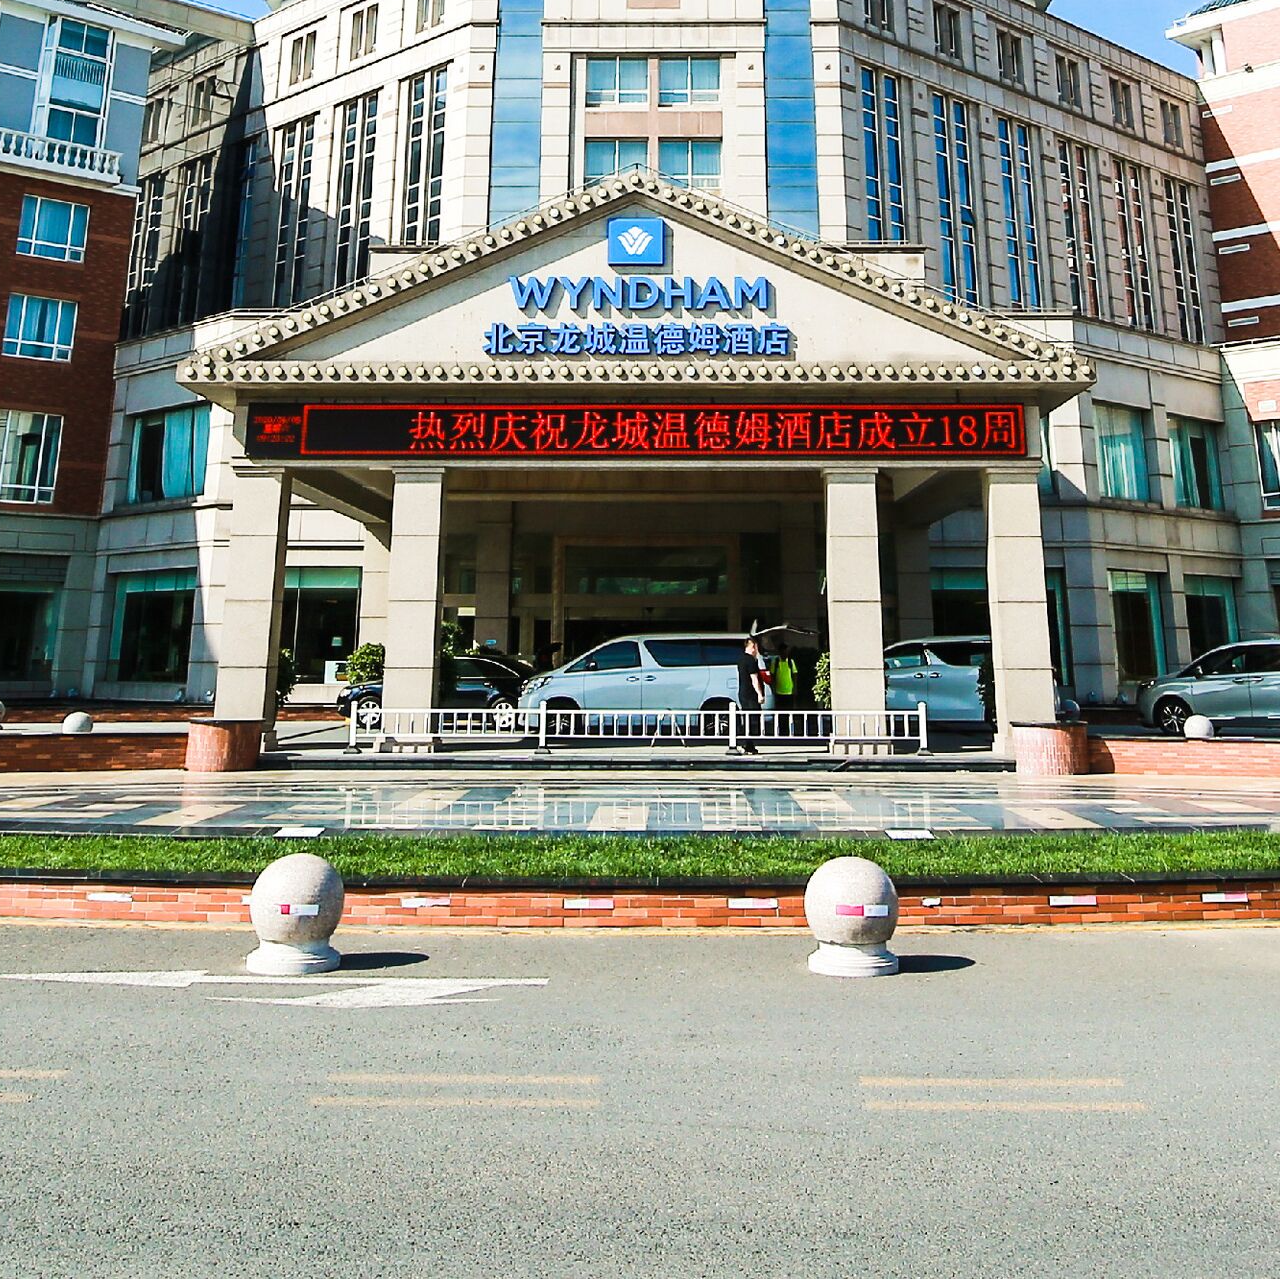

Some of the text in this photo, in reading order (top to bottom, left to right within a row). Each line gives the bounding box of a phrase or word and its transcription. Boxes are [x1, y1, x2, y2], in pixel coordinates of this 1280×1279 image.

[509, 276, 770, 310] WYNDHAM
[483, 322, 790, 356] 北京龙城温德姆酒店
[408, 411, 1016, 450] 热烈庆祝龙城温德姆酒店成立18周
